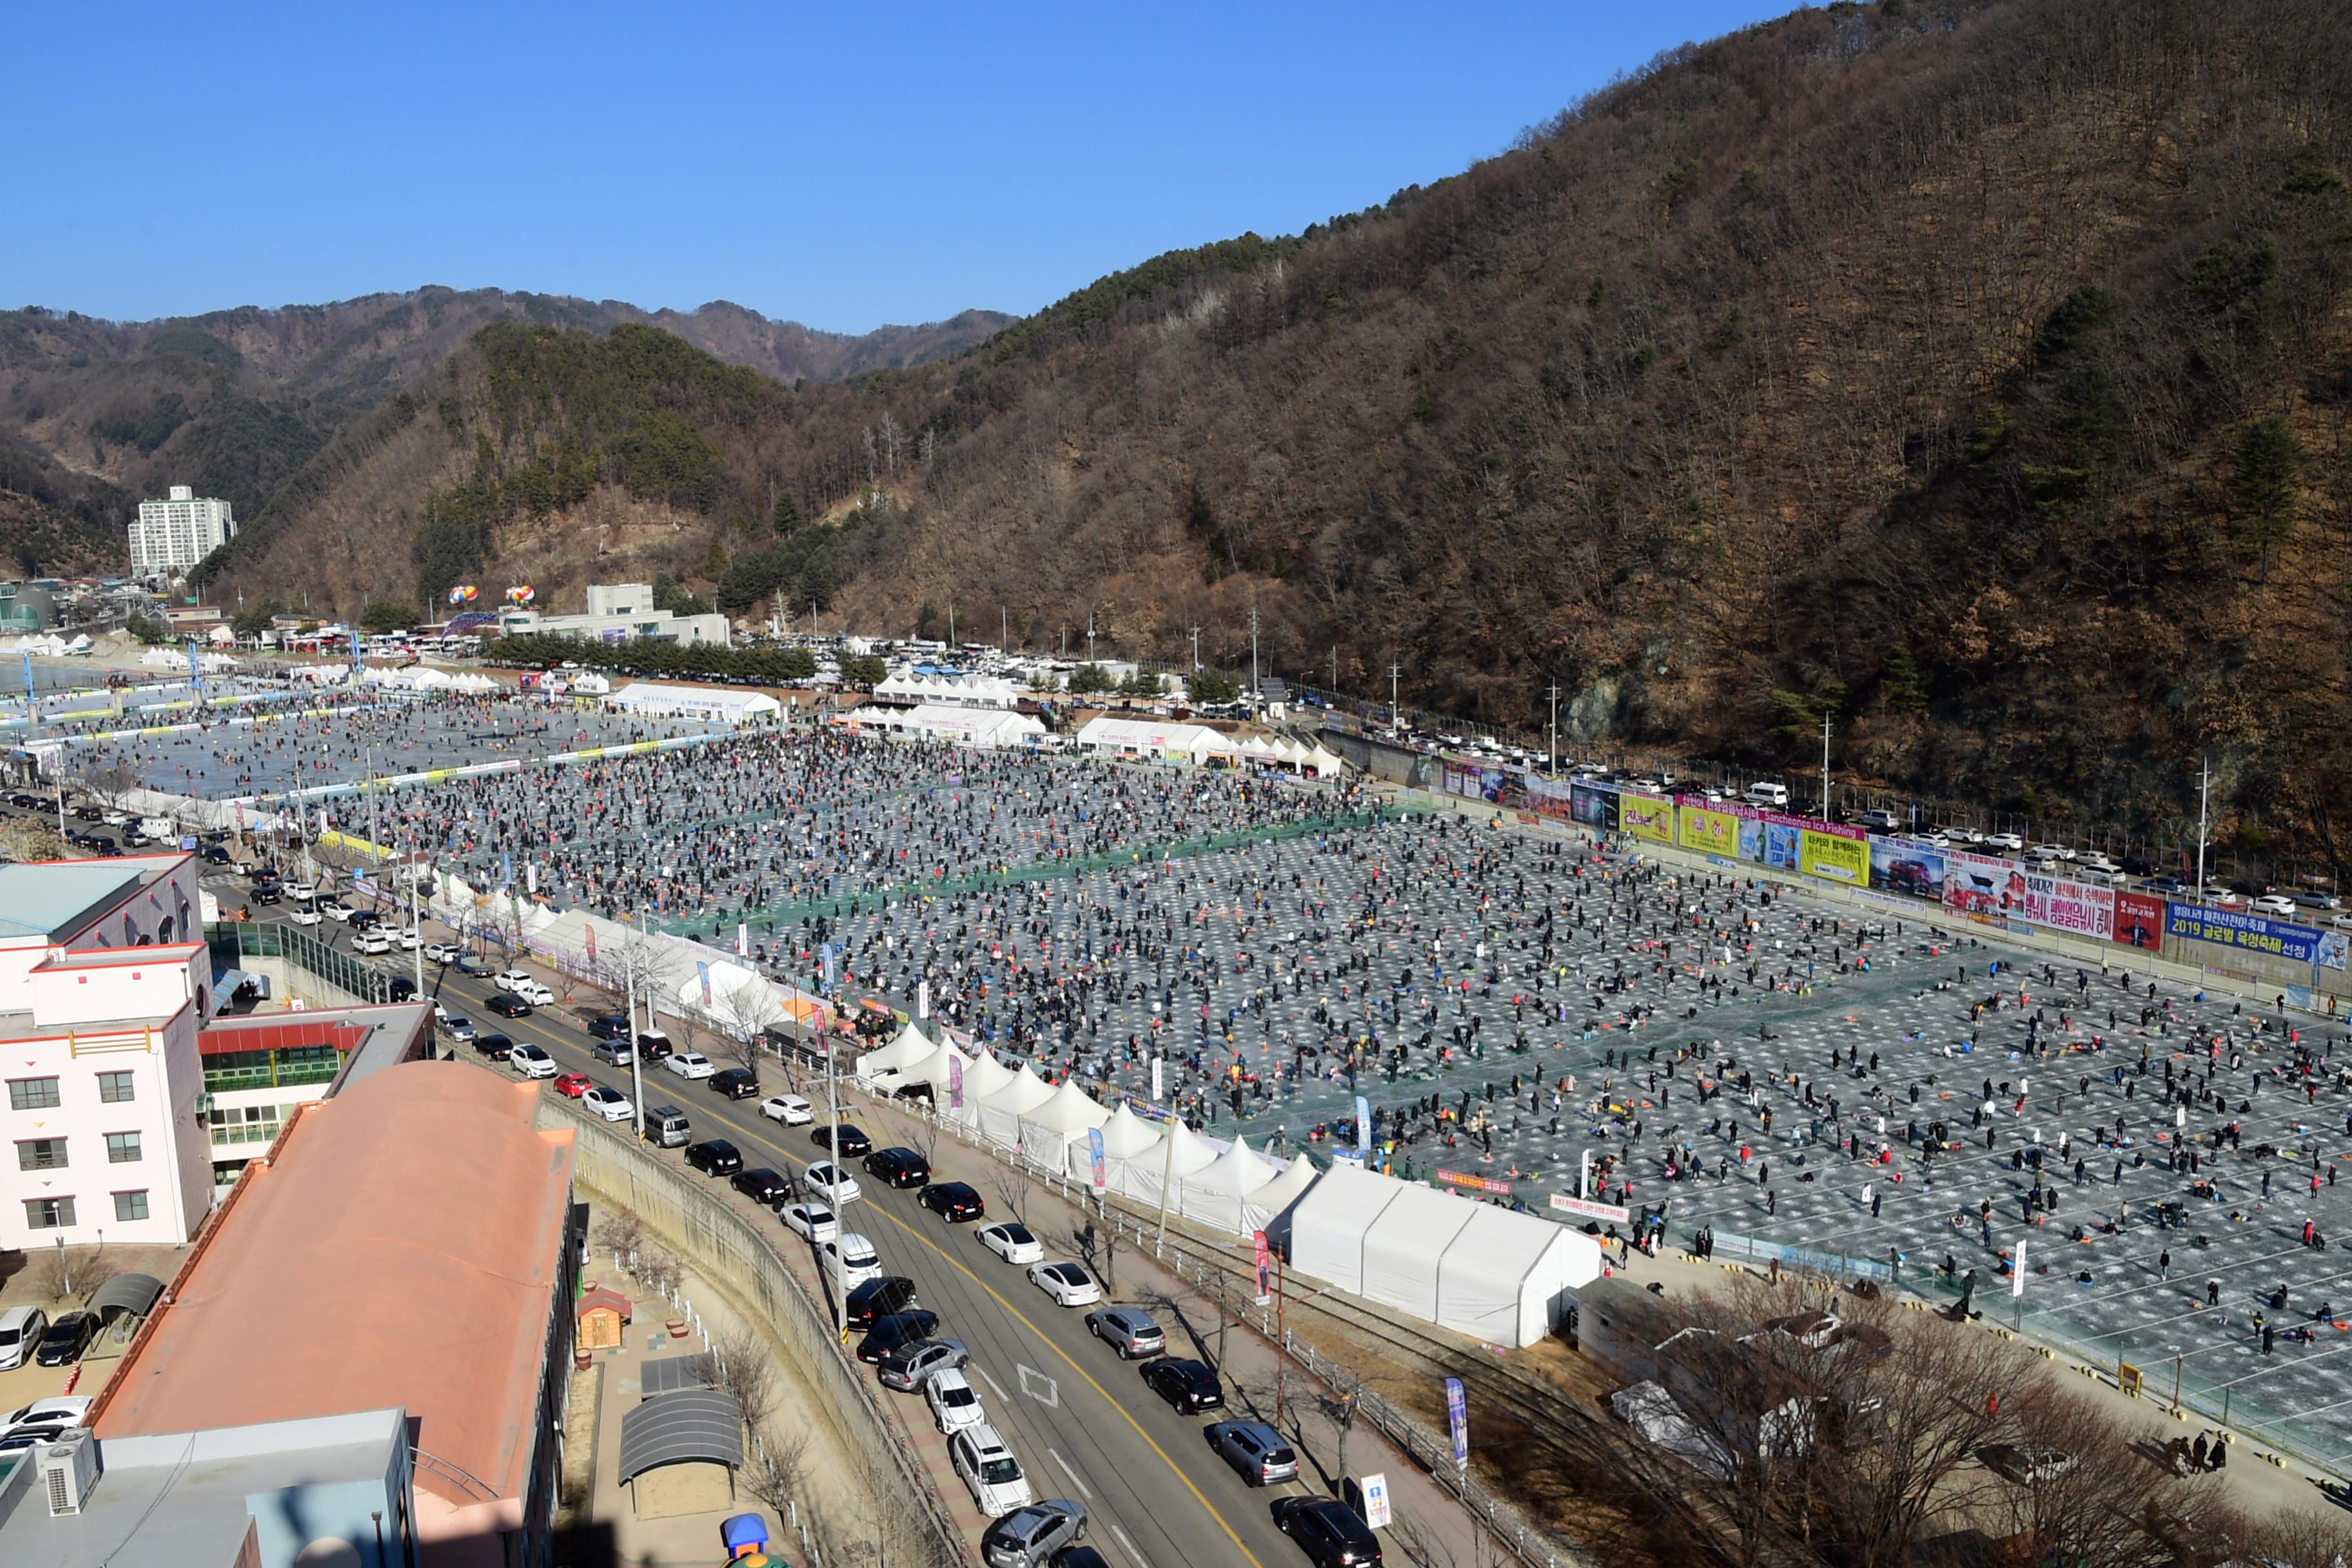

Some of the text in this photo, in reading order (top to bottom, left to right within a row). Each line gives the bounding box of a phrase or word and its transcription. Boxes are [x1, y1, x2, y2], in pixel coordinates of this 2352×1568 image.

[1813, 819, 1825, 831] Ice
[1826, 821, 1856, 839] Fishing
[2171, 918, 2201, 935] 2019
[2203, 923, 2234, 943] 글로벌
